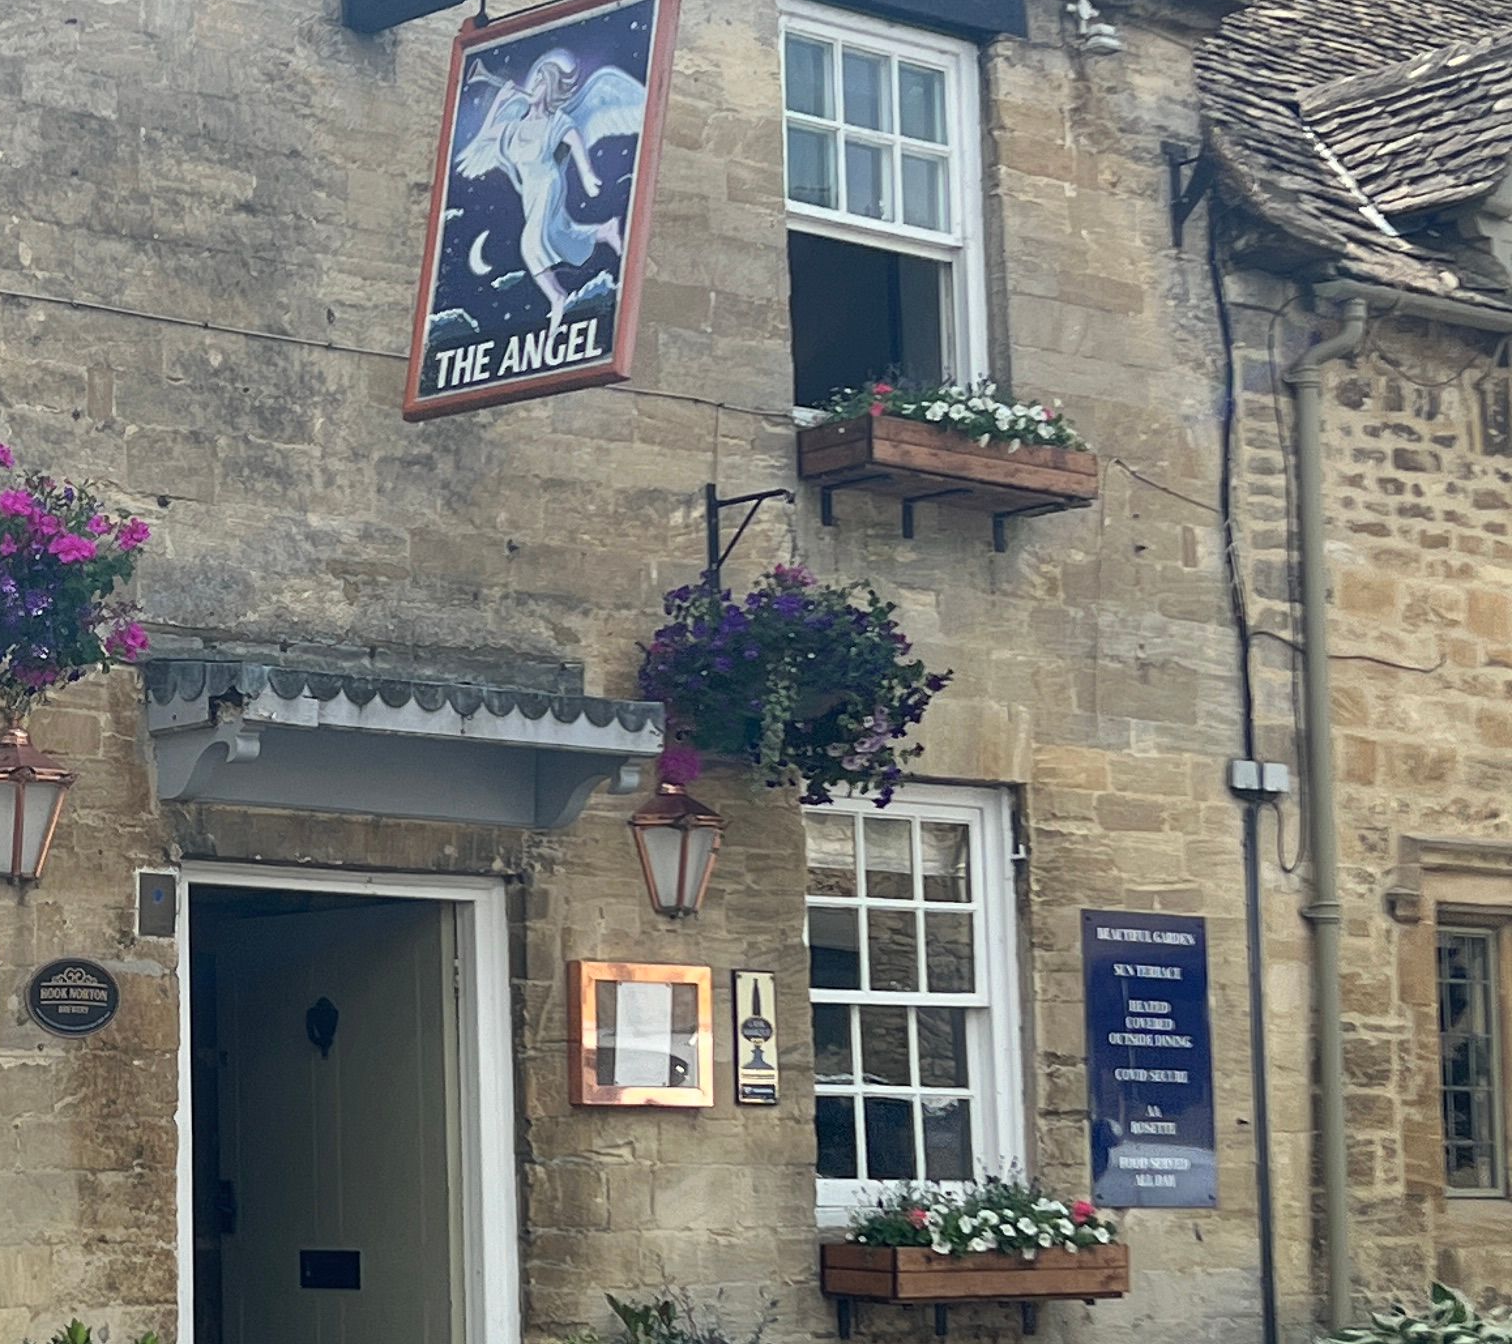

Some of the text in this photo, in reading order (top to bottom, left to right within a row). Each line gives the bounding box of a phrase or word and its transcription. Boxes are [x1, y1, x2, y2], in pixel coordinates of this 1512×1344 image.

[436, 318, 603, 388] THE ANGEL
[1097, 927, 1196, 946] BEAUTIFUL GARDEN
[1113, 963, 1183, 980] SUN TERRACE
[40, 986, 108, 1002] HOOK NORTON
[1128, 999, 1172, 1014] HEATED
[1125, 1016, 1176, 1031] COVERED
[1108, 1032, 1194, 1049] OUTSIDE DINING
[1114, 1068, 1189, 1084] COVID SECURE
[1145, 1104, 1164, 1118] AA
[1130, 1121, 1176, 1135] ROSETTE
[1118, 1156, 1192, 1171] FOOD SERVED
[1134, 1173, 1176, 1188] ALL DAY
